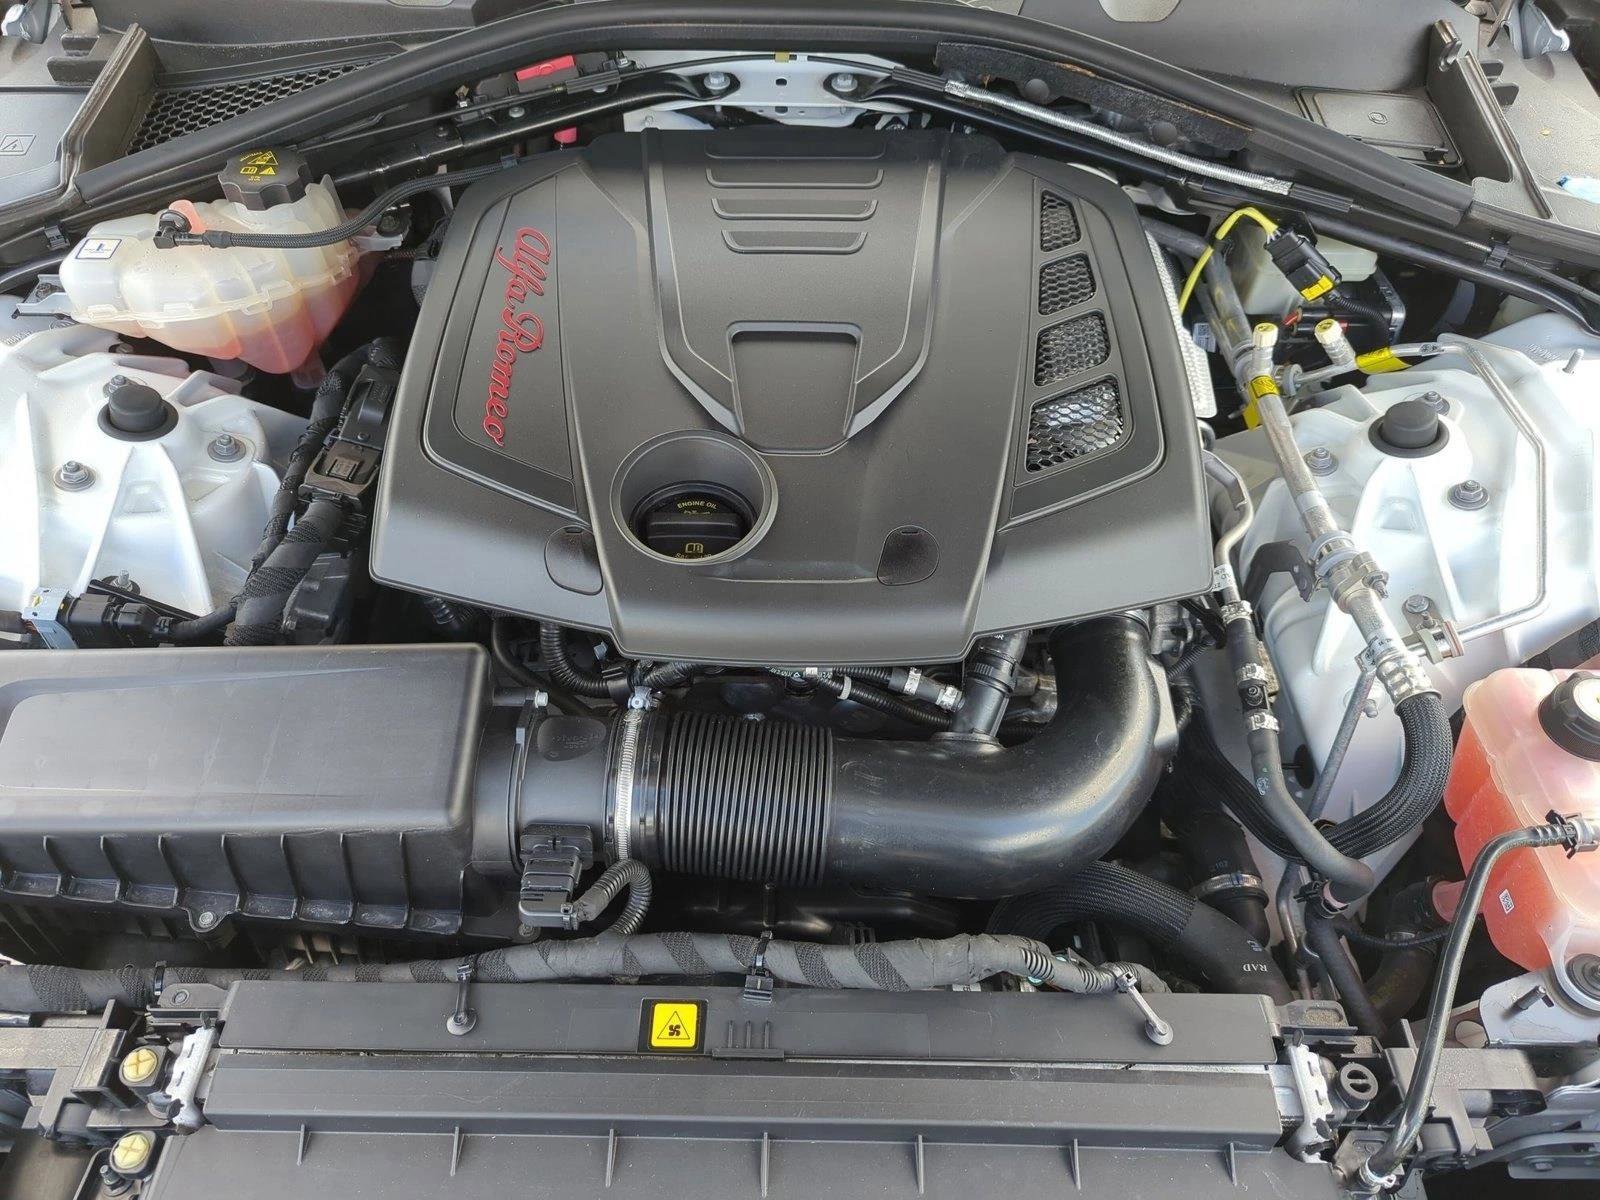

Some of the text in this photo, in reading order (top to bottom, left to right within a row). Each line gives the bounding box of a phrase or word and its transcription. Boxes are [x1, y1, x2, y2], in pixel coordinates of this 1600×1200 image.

[483, 226, 551, 448] Alfa Romeo
[677, 500, 718, 510] ENGINE OIL
[1242, 963, 1269, 972] RAD
